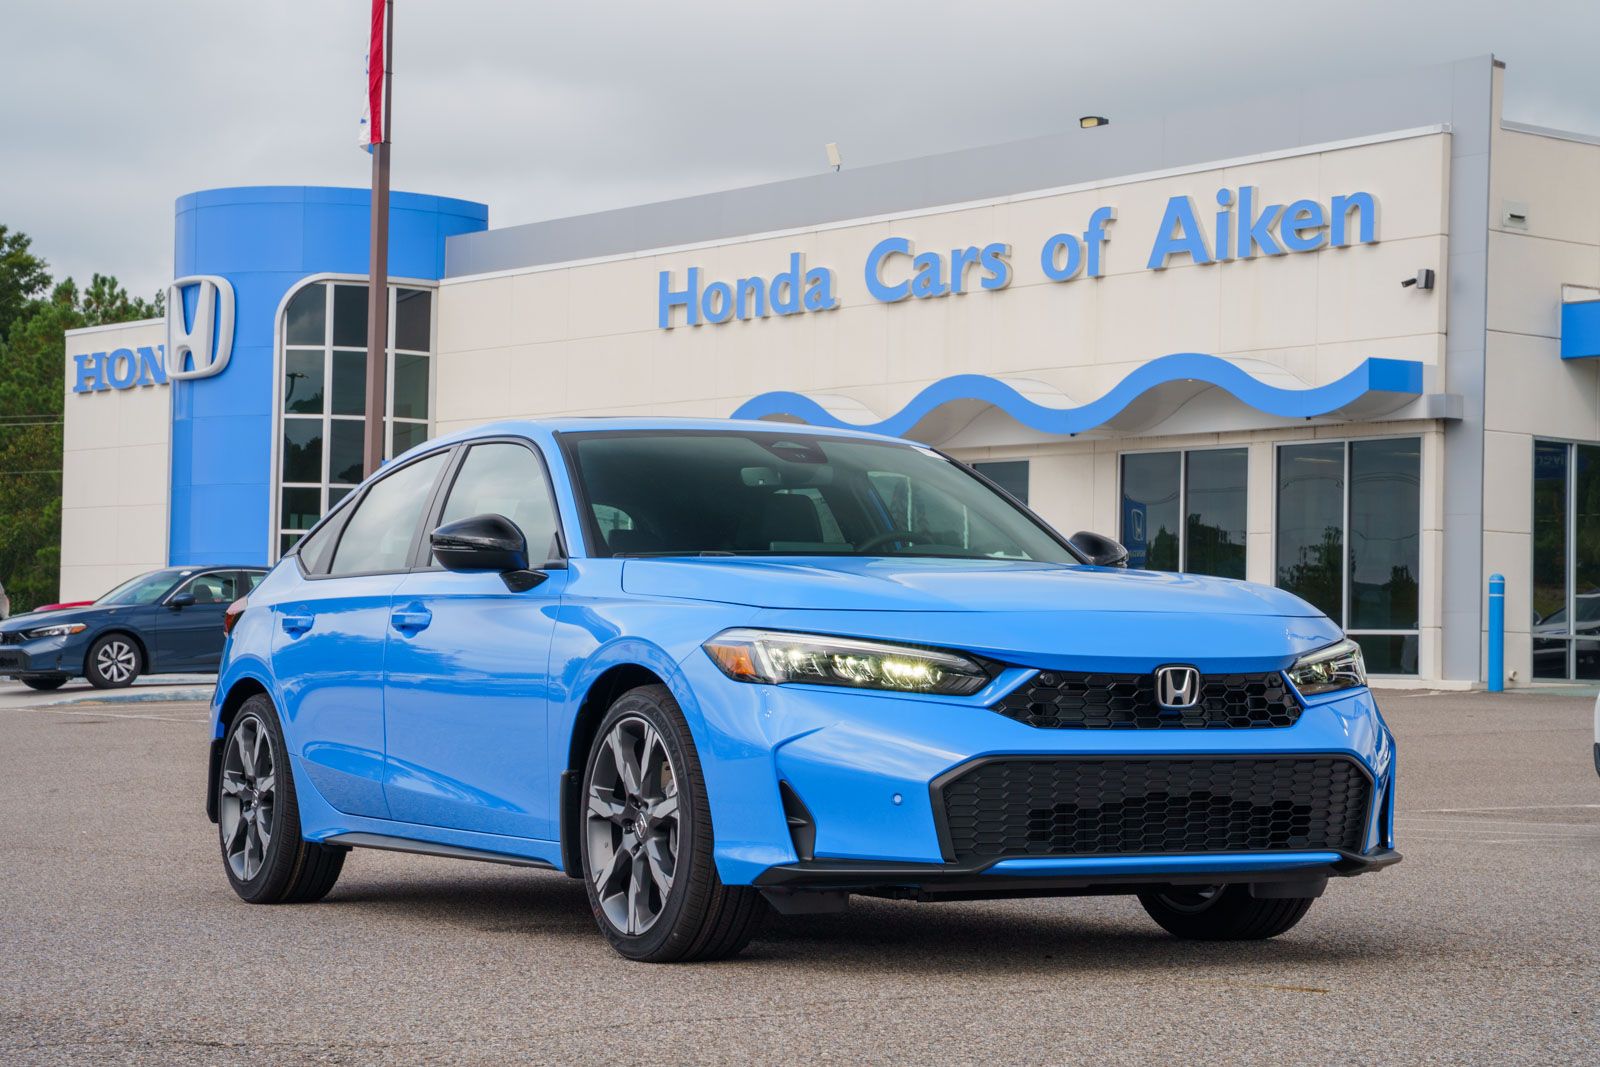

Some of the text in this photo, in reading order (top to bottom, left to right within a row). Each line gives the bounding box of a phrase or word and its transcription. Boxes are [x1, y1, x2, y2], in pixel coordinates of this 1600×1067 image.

[658, 186, 1378, 330] Honda Cars of Aiken
[73, 344, 167, 394] HON
